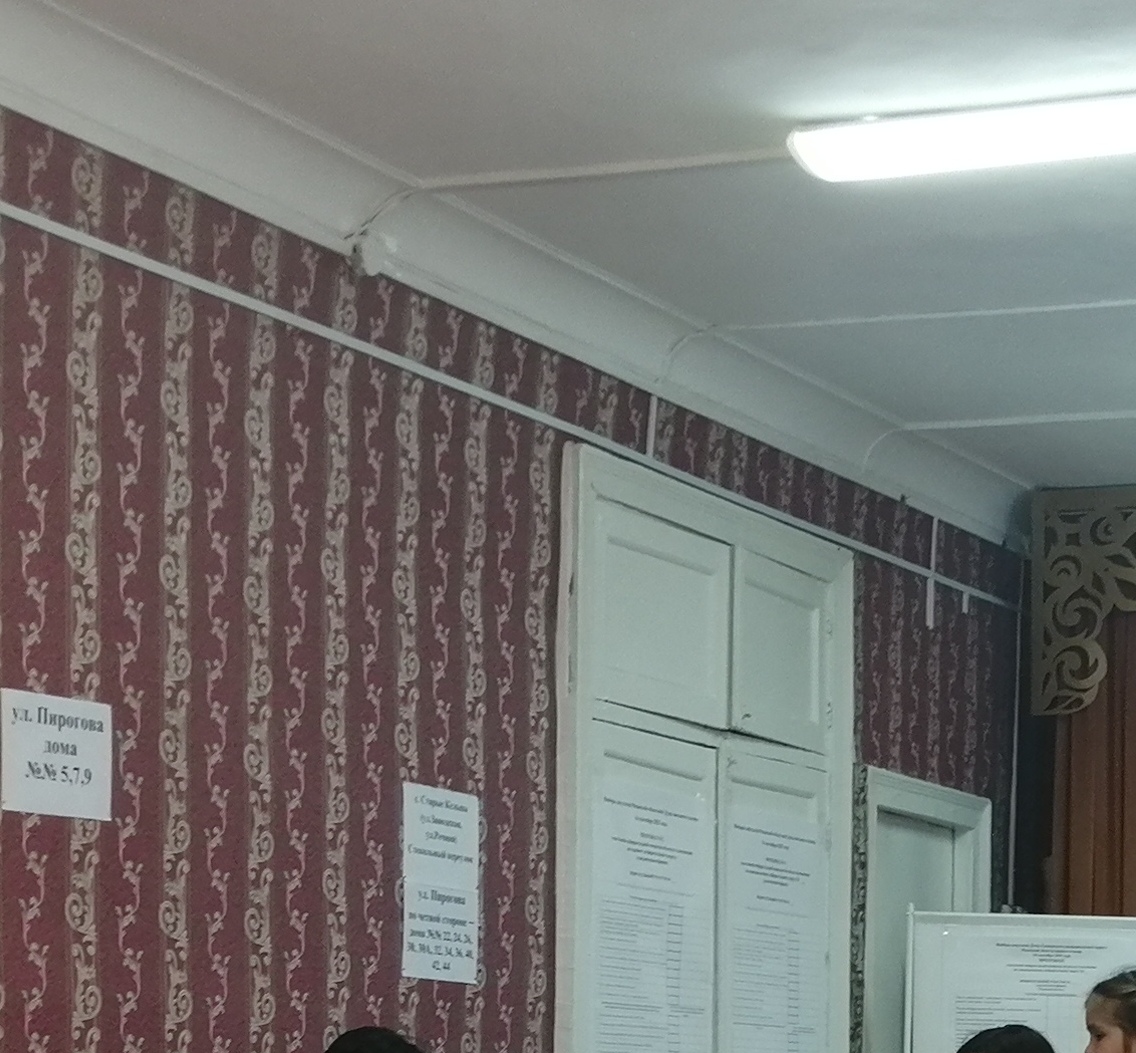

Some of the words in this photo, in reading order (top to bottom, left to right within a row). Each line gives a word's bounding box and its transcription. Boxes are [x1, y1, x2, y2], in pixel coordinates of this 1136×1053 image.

[11, 707, 32, 725] ул.
[37, 705, 104, 733] Пирогова
[43, 740, 78, 756] дома
[418, 890, 429, 901] ул.
[431, 889, 465, 905] Пирогова
